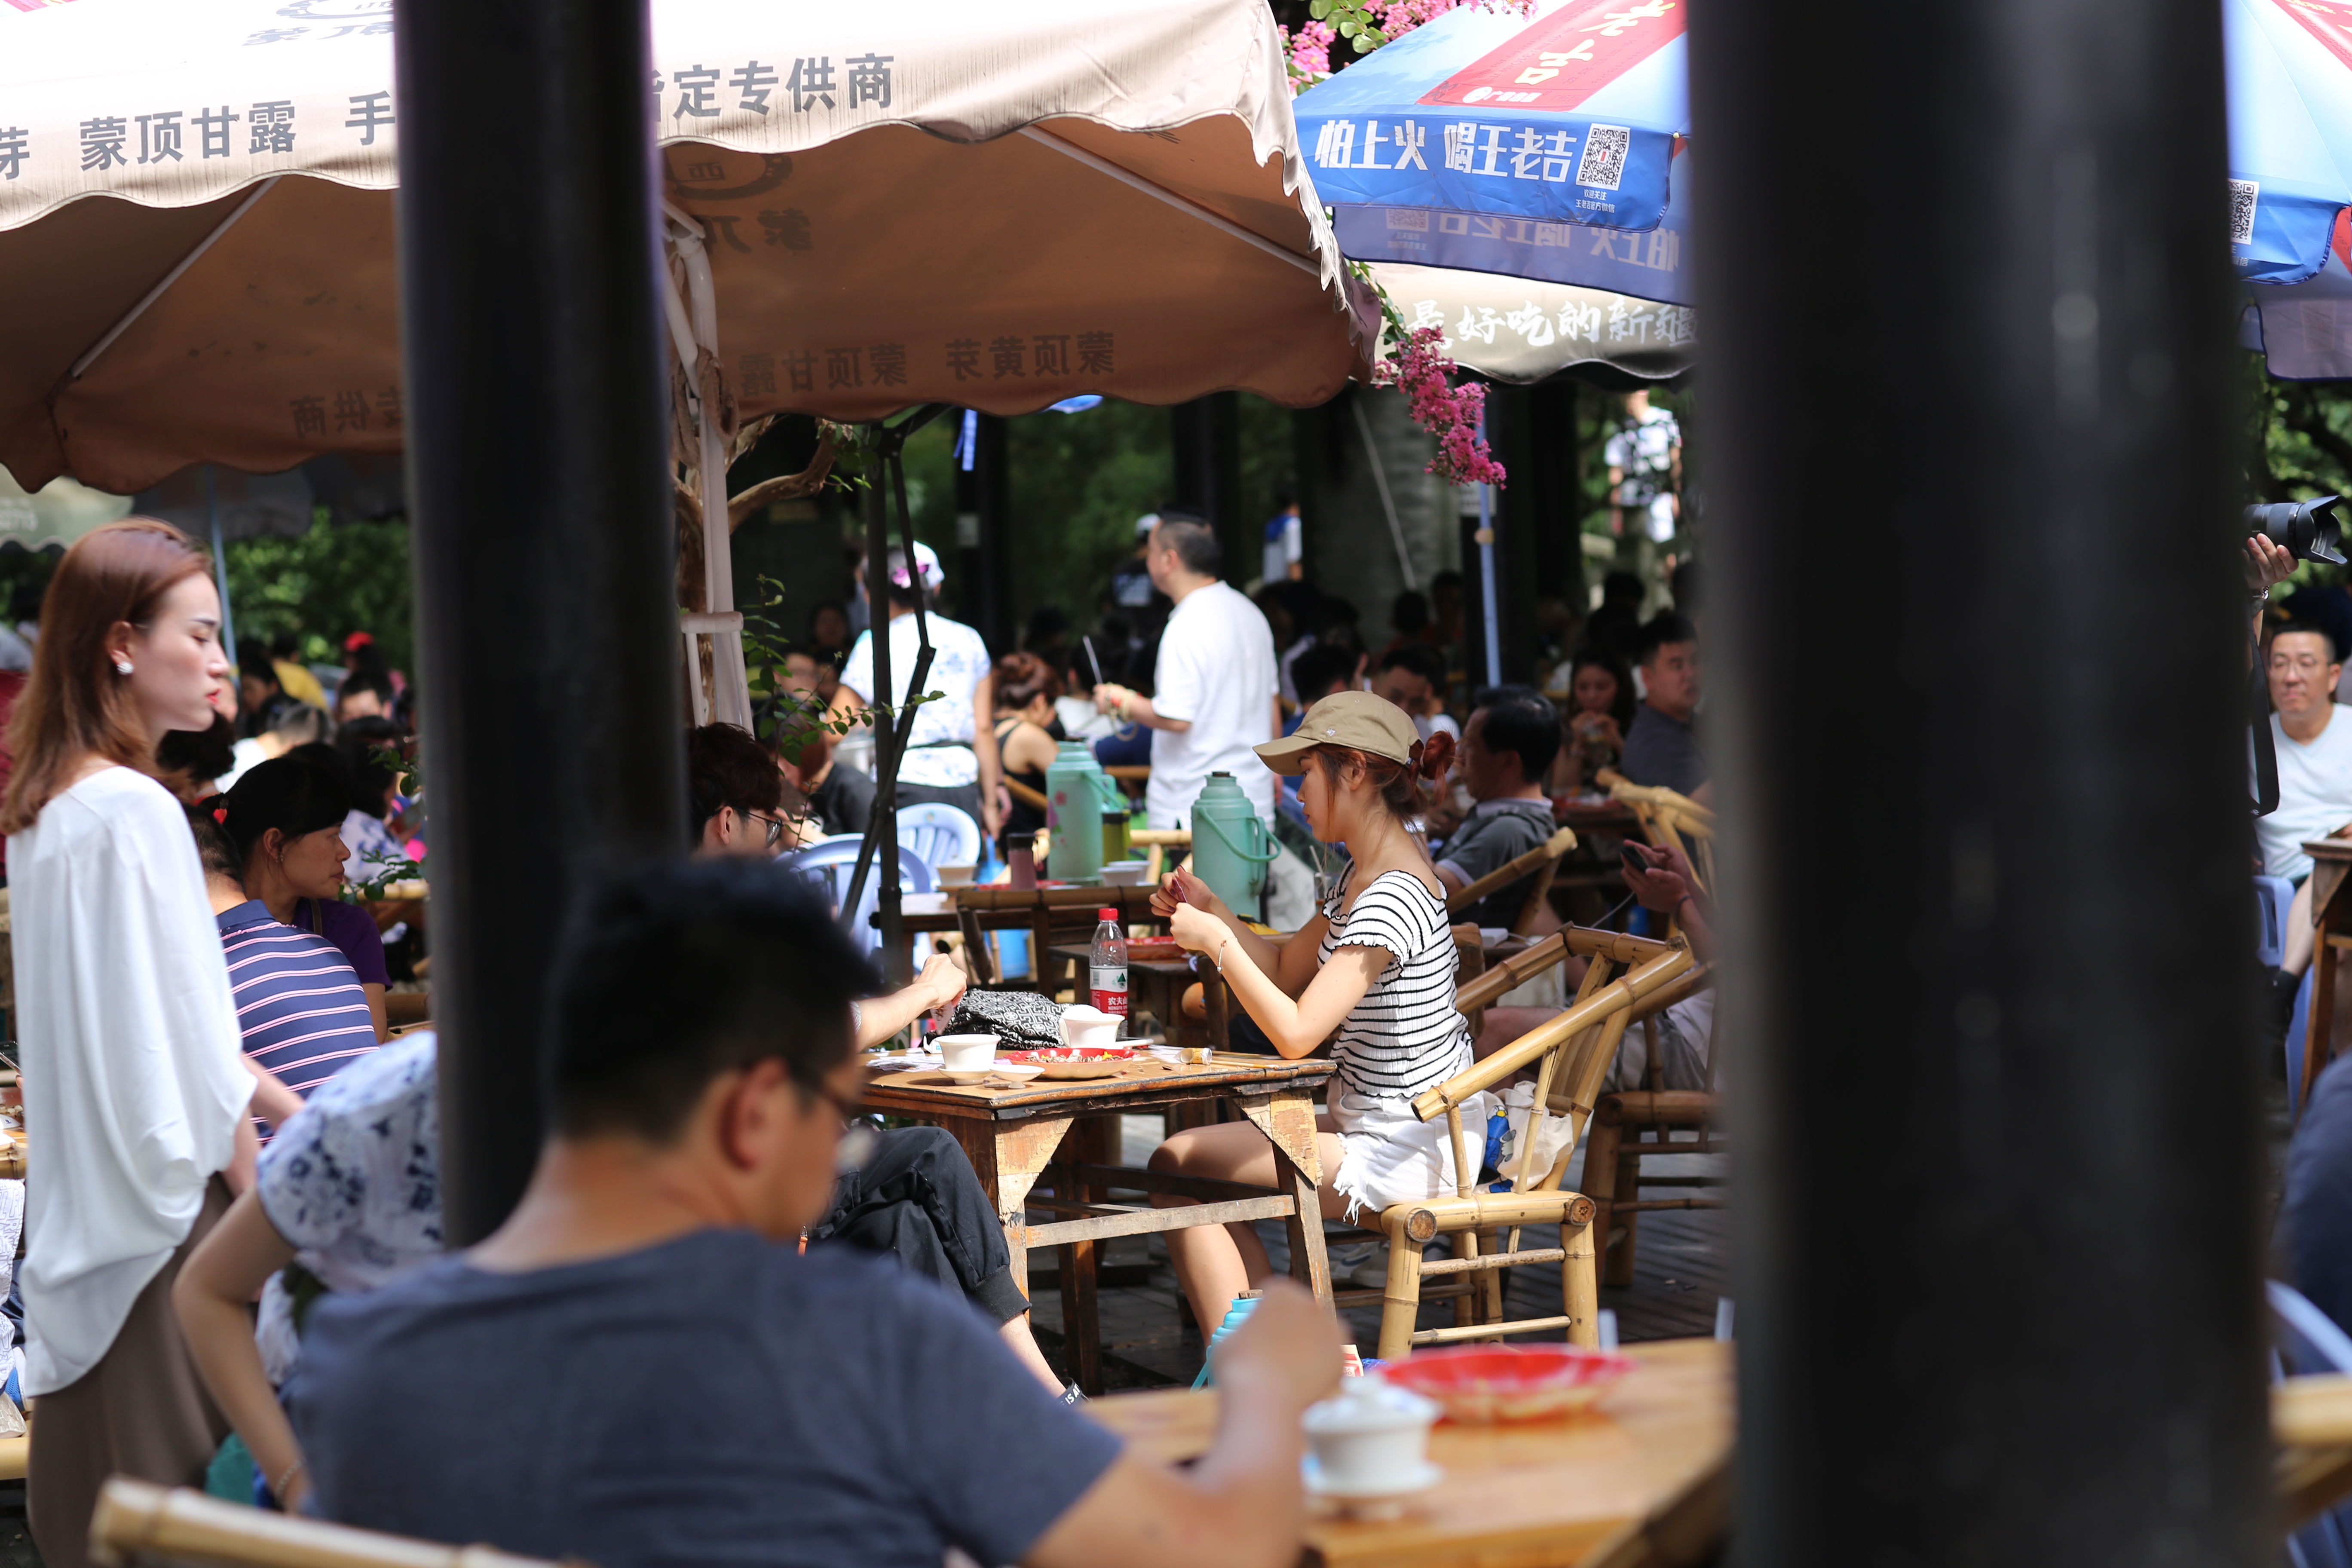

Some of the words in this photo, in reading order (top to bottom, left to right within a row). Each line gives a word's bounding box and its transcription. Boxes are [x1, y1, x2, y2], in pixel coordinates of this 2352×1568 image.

[80, 100, 296, 172] 蒙顶甘露
[345, 91, 395, 145] 手
[1315, 119, 1428, 170] 怕上火
[1444, 122, 1577, 182] 喝王老吉
[1575, 199, 1616, 213] 王老吉官方微信
[1584, 189, 1607, 200] 欢迎关注
